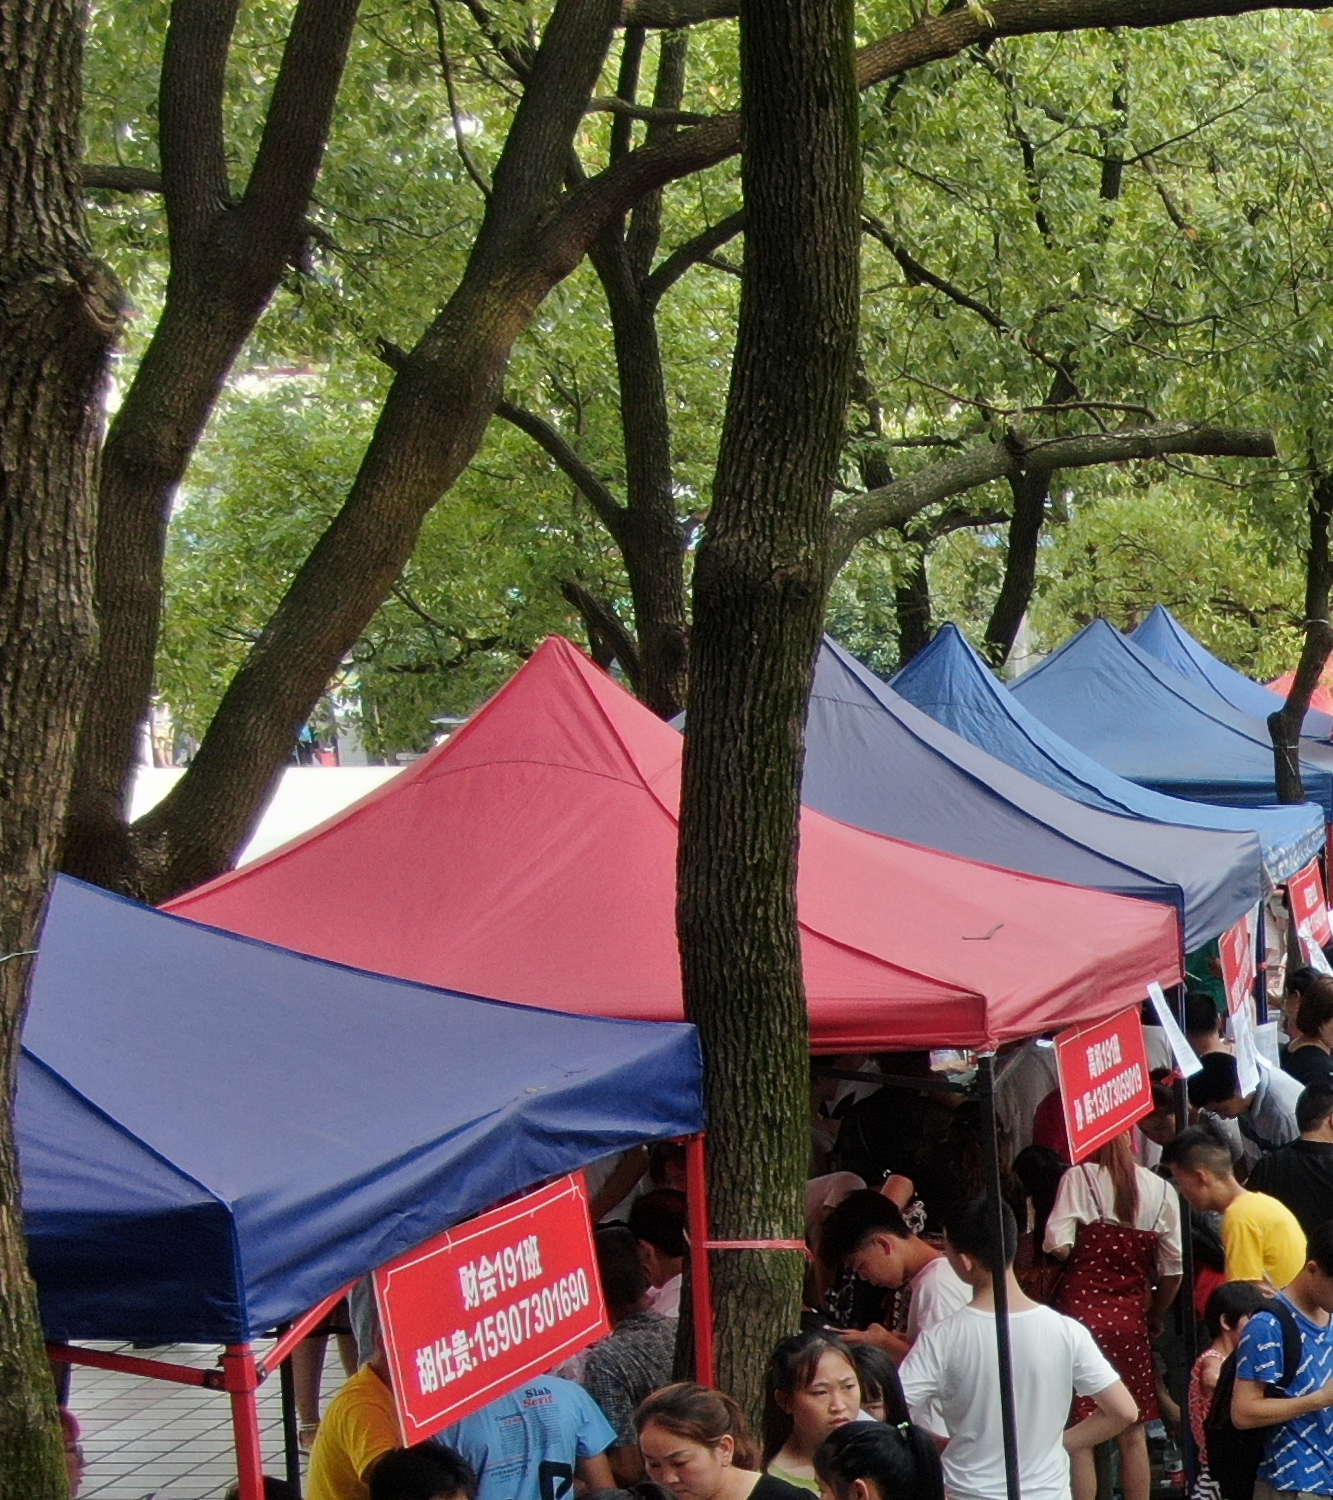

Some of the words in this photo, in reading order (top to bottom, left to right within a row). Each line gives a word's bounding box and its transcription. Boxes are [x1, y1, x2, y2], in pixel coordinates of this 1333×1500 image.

[459, 1235, 543, 1311] 财会191班
[416, 1267, 590, 1395] 胡仕贵:15907301690
[524, 1387, 552, 1398] Slab
